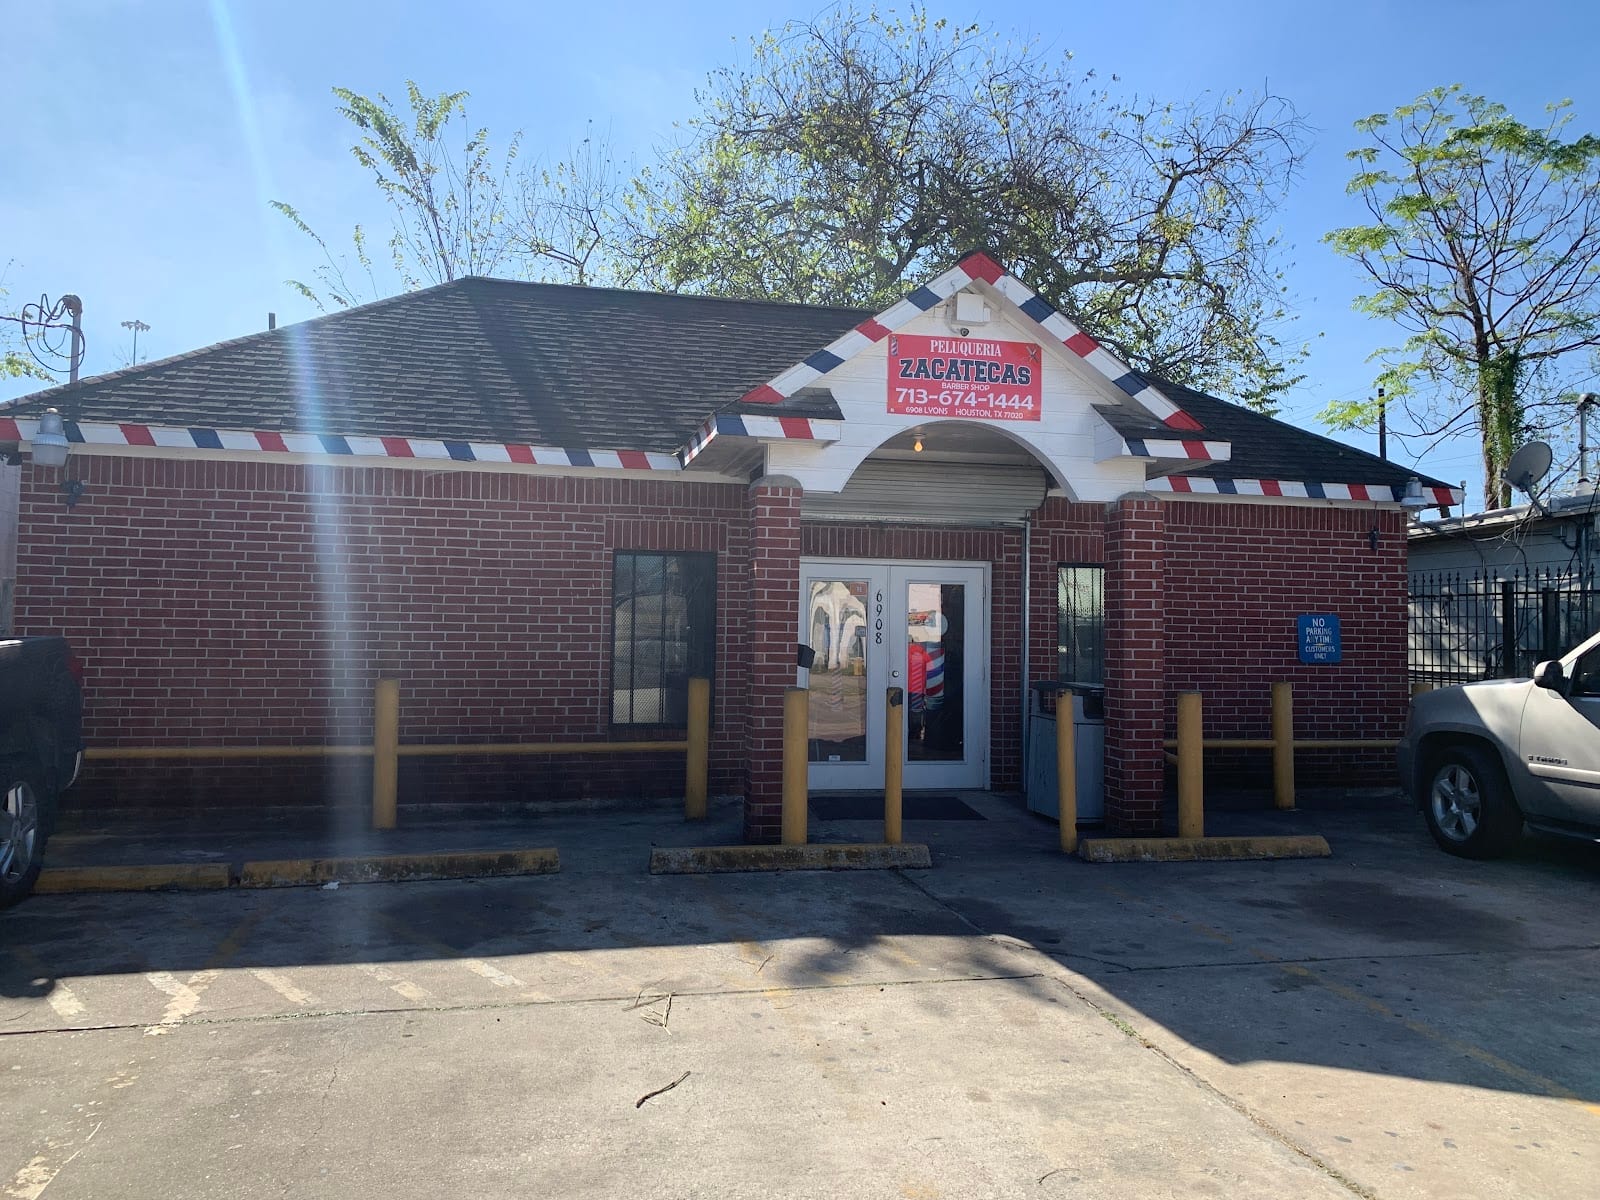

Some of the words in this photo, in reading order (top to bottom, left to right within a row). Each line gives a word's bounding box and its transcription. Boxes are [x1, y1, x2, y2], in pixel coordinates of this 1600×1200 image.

[930, 340, 1002, 357] PELUQUERIA
[899, 358, 1031, 385] ZACATECAS
[896, 388, 1034, 410] 713-674-1444
[924, 407, 948, 415] LYONS
[1004, 411, 1023, 419] 77020
[1312, 618, 1325, 627] NO
[1306, 627, 1332, 635] PARKING
